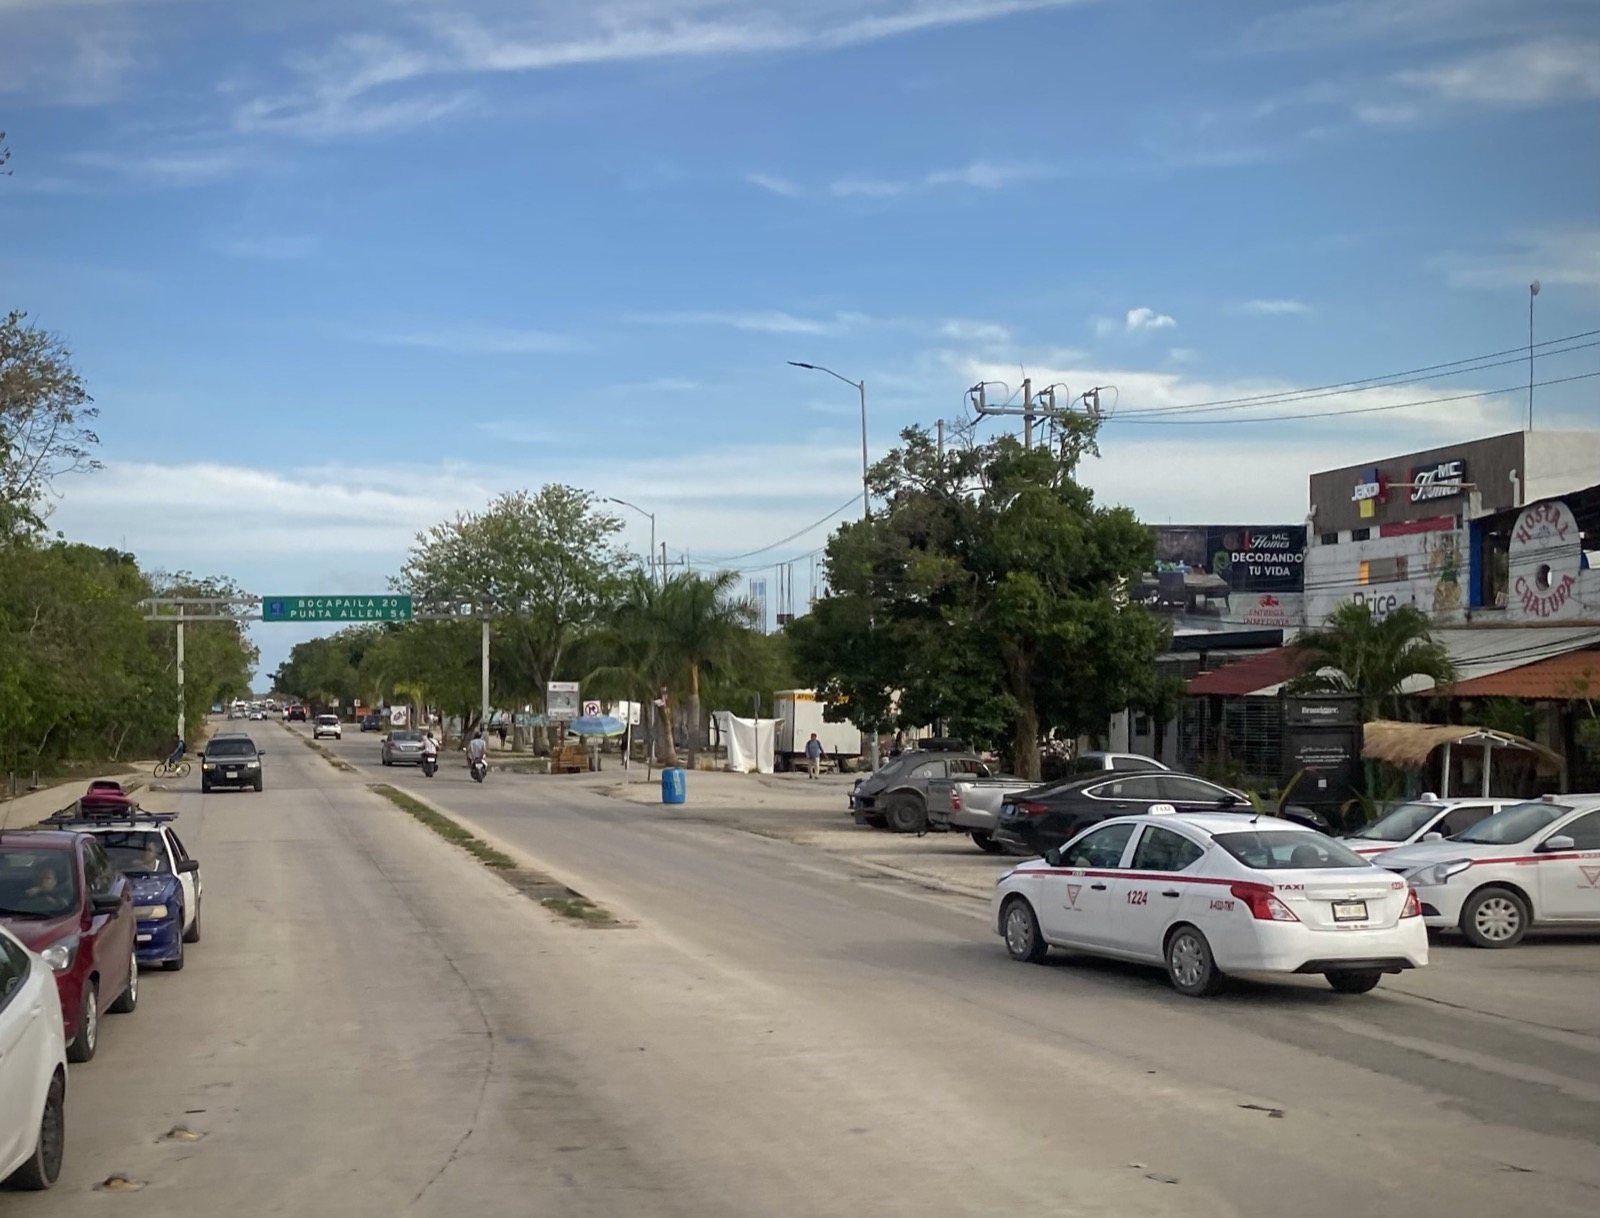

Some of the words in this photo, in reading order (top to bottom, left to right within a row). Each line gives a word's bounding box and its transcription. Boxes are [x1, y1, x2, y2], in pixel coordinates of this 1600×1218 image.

[1437, 461, 1462, 478] MC
[1516, 504, 1569, 544] HOSTAL
[1249, 535, 1290, 549] Homes
[1271, 533, 1289, 541] MC
[1231, 552, 1303, 563] DECORANDO
[1249, 566, 1261, 576] TU
[1265, 566, 1291, 576] VIDA
[1515, 574, 1576, 617] CHALUPA
[298, 599, 375, 608] BOCAPAILA
[383, 599, 398, 608] 20
[290, 609, 332, 618] PUNTA
[340, 609, 383, 618] ALLEN
[390, 609, 406, 618] 56
[1126, 890, 1149, 905] 1224
